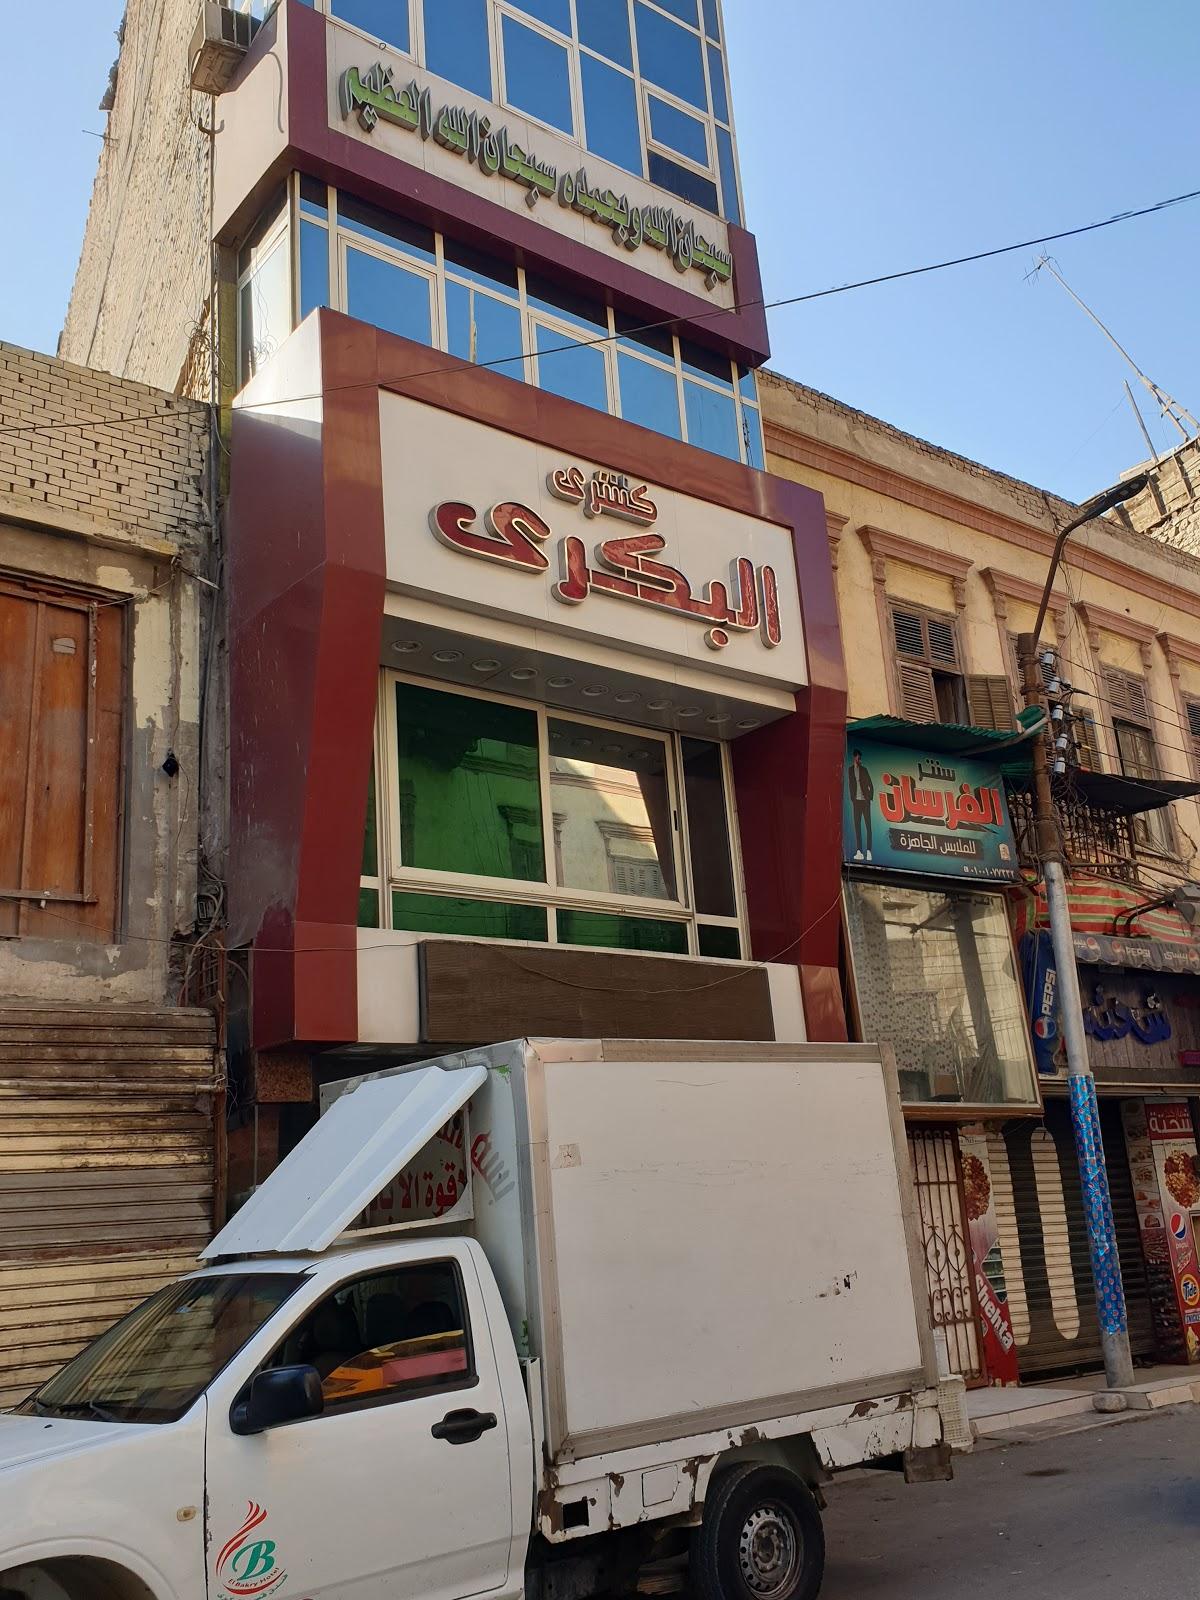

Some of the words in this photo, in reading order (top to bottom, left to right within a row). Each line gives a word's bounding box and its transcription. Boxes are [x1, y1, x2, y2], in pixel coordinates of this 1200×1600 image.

[338, 61, 431, 142] العظيم
[433, 102, 480, 164] الله
[478, 115, 557, 209] سبحان
[557, 166, 643, 252] وبحمده
[641, 203, 678, 260] الله
[672, 221, 732, 292] سبحان
[917, 758, 956, 782] سنتر
[878, 773, 1003, 830] الفرسان
[900, 832, 938, 850] الجاهزة
[940, 836, 976, 855] للملابس
[1125, 946, 1151, 959] PEPSI
[1041, 967, 1057, 1016] PEPSI
[1183, 1280, 1198, 1300] Tide
[231, 1540, 276, 1581] B
[259, 1566, 280, 1584] Hotel
